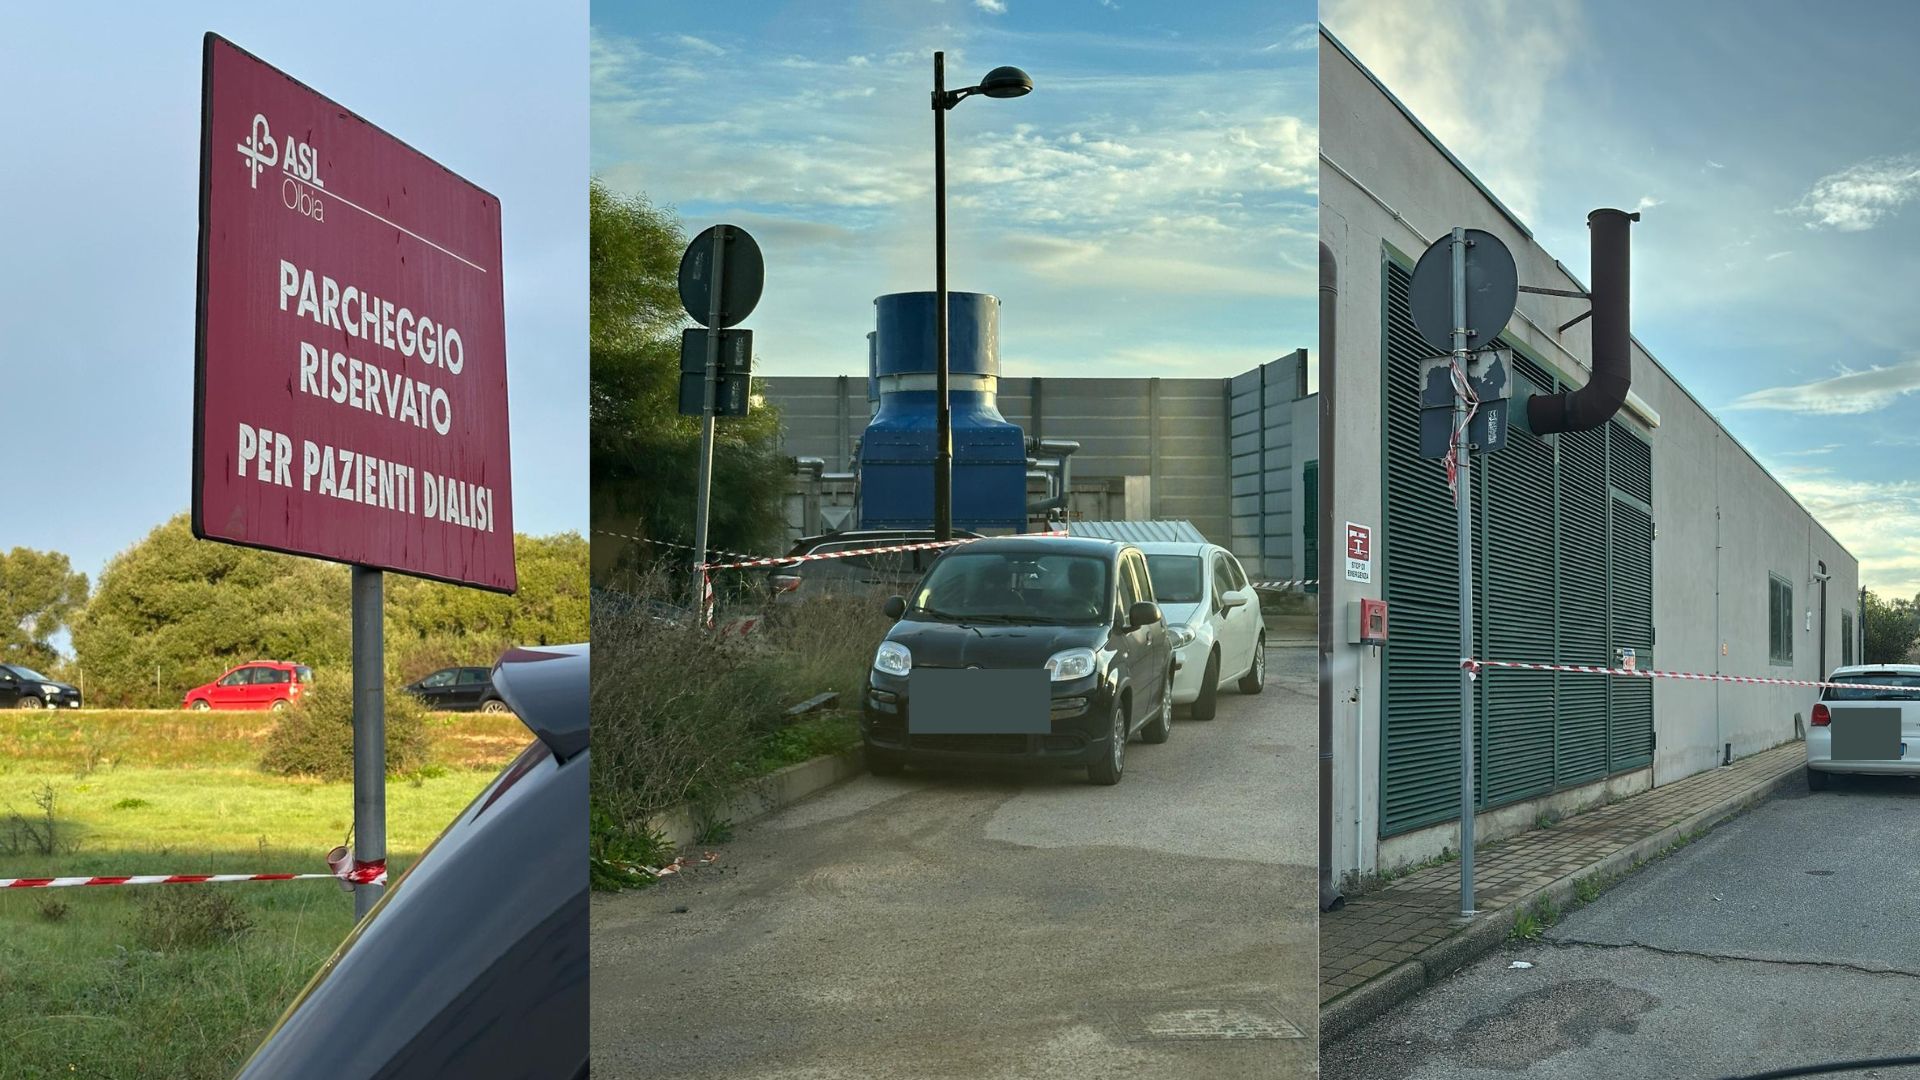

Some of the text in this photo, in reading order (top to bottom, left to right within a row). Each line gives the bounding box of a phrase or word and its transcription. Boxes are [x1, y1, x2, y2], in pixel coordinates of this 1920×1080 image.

[283, 135, 324, 187] ASL
[282, 177, 325, 223] Olbia
[279, 258, 464, 375] PARCHEGGIO
[300, 341, 452, 436] RISERVATO
[238, 422, 494, 533] PER PAZIENTI DIALISI
[1348, 569, 1368, 579] EMERGENZA
